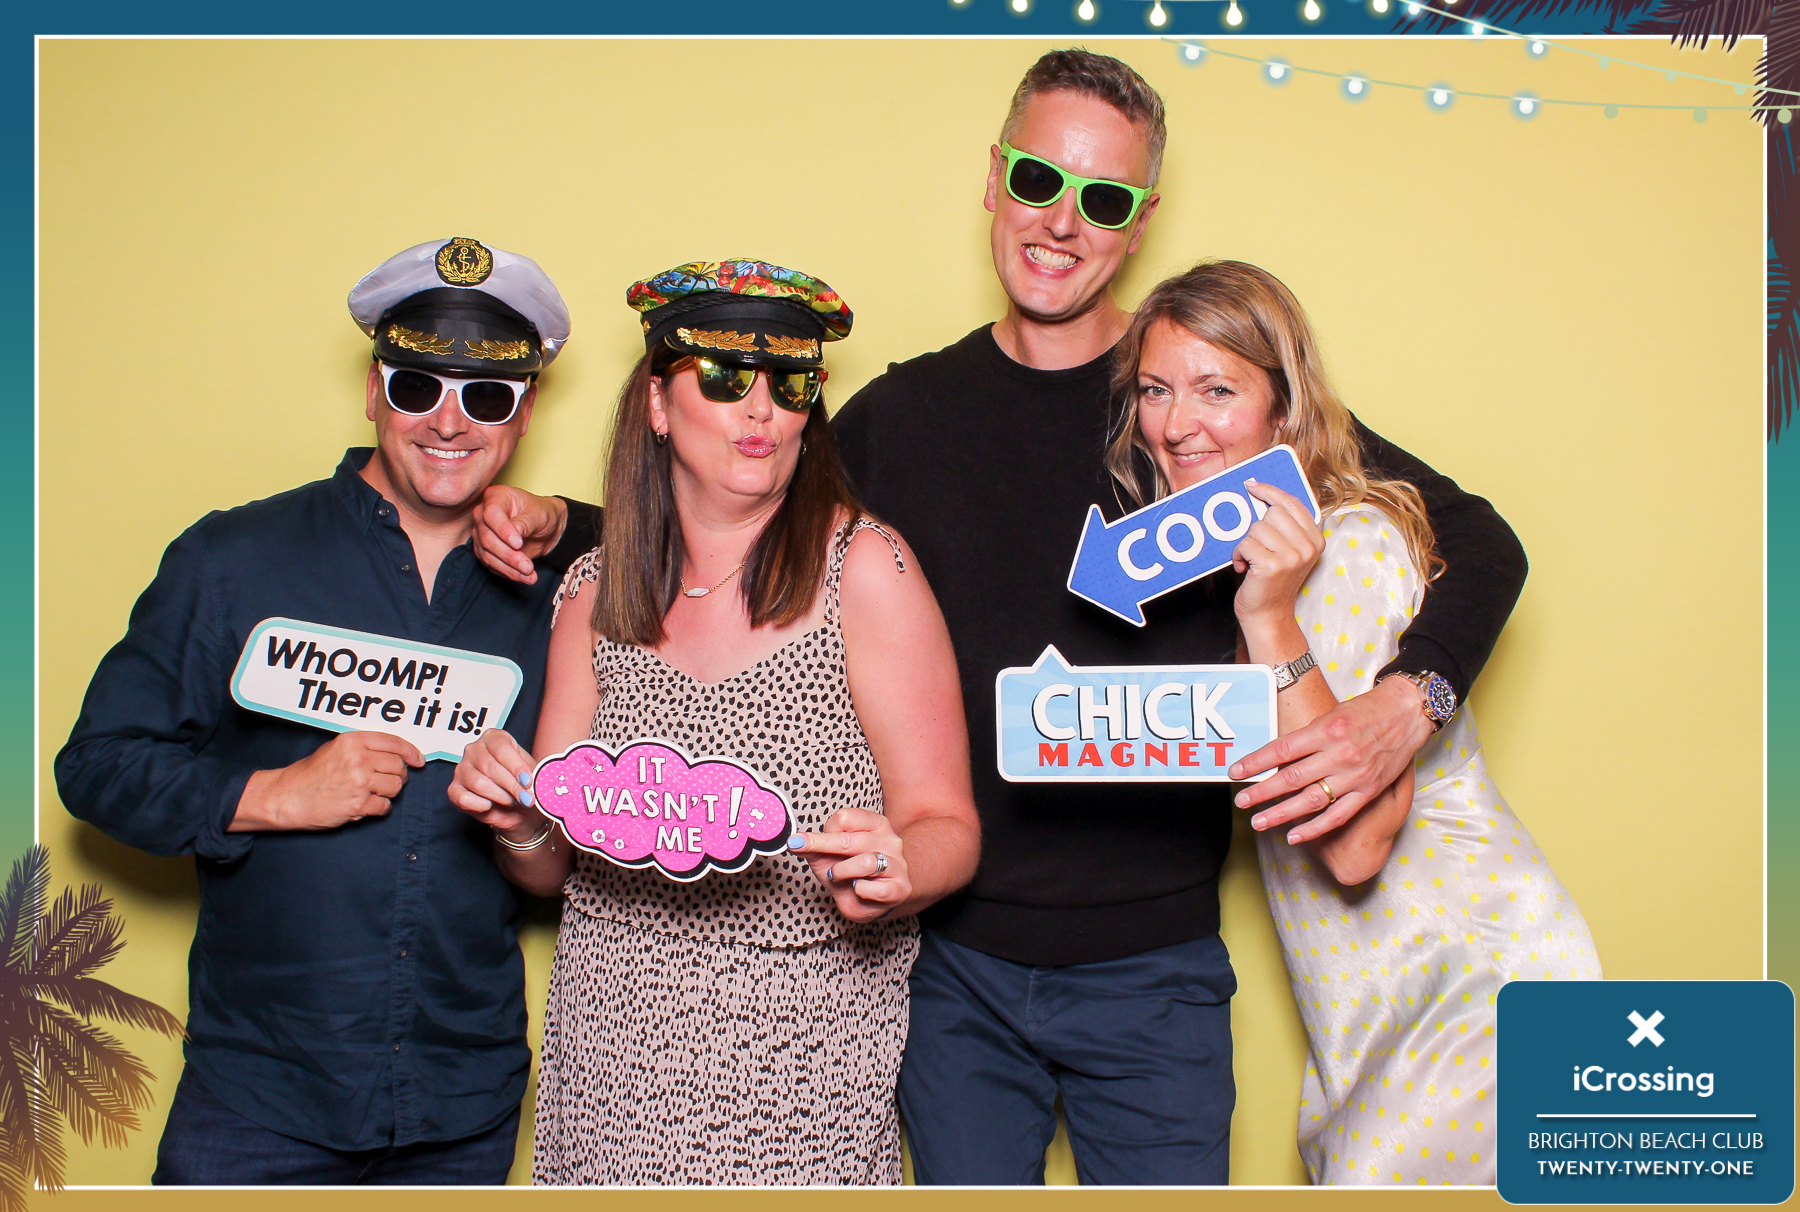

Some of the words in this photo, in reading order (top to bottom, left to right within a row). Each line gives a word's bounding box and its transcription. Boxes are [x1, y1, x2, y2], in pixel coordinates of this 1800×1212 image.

[267, 635, 449, 695] WhOoMP!
[298, 678, 406, 722] There
[413, 696, 442, 728] it
[447, 702, 488, 735] is!
[1031, 682, 1237, 741] CHICK
[637, 756, 666, 784] IT
[1038, 742, 1234, 767] MAGNET
[582, 786, 719, 823] WASN'T
[655, 826, 703, 853] ME
